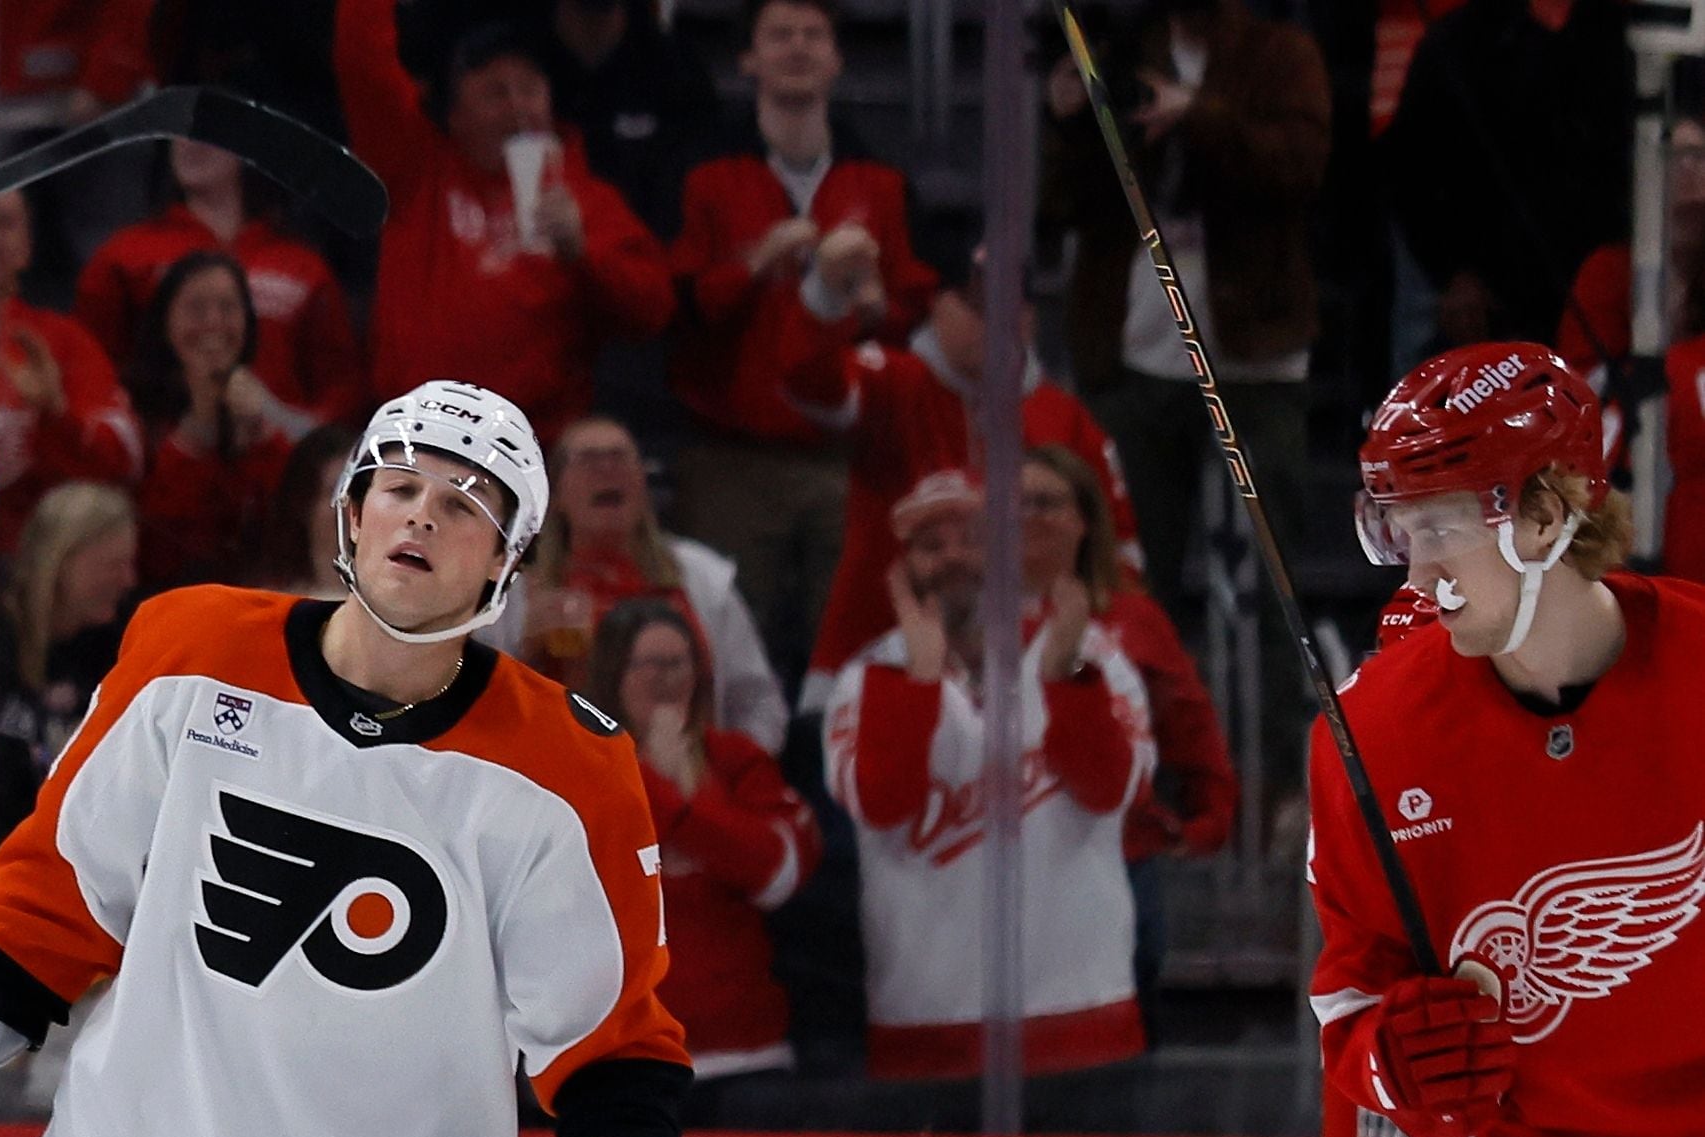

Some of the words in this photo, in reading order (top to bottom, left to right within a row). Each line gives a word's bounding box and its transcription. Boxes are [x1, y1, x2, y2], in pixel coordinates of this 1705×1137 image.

[1453, 354, 1527, 414] meijer
[421, 400, 483, 424] CCM
[1382, 613, 1414, 626] CCM
[187, 729, 212, 744] Penn
[214, 736, 259, 758] Medicine
[1390, 817, 1453, 844] PRIORITY
